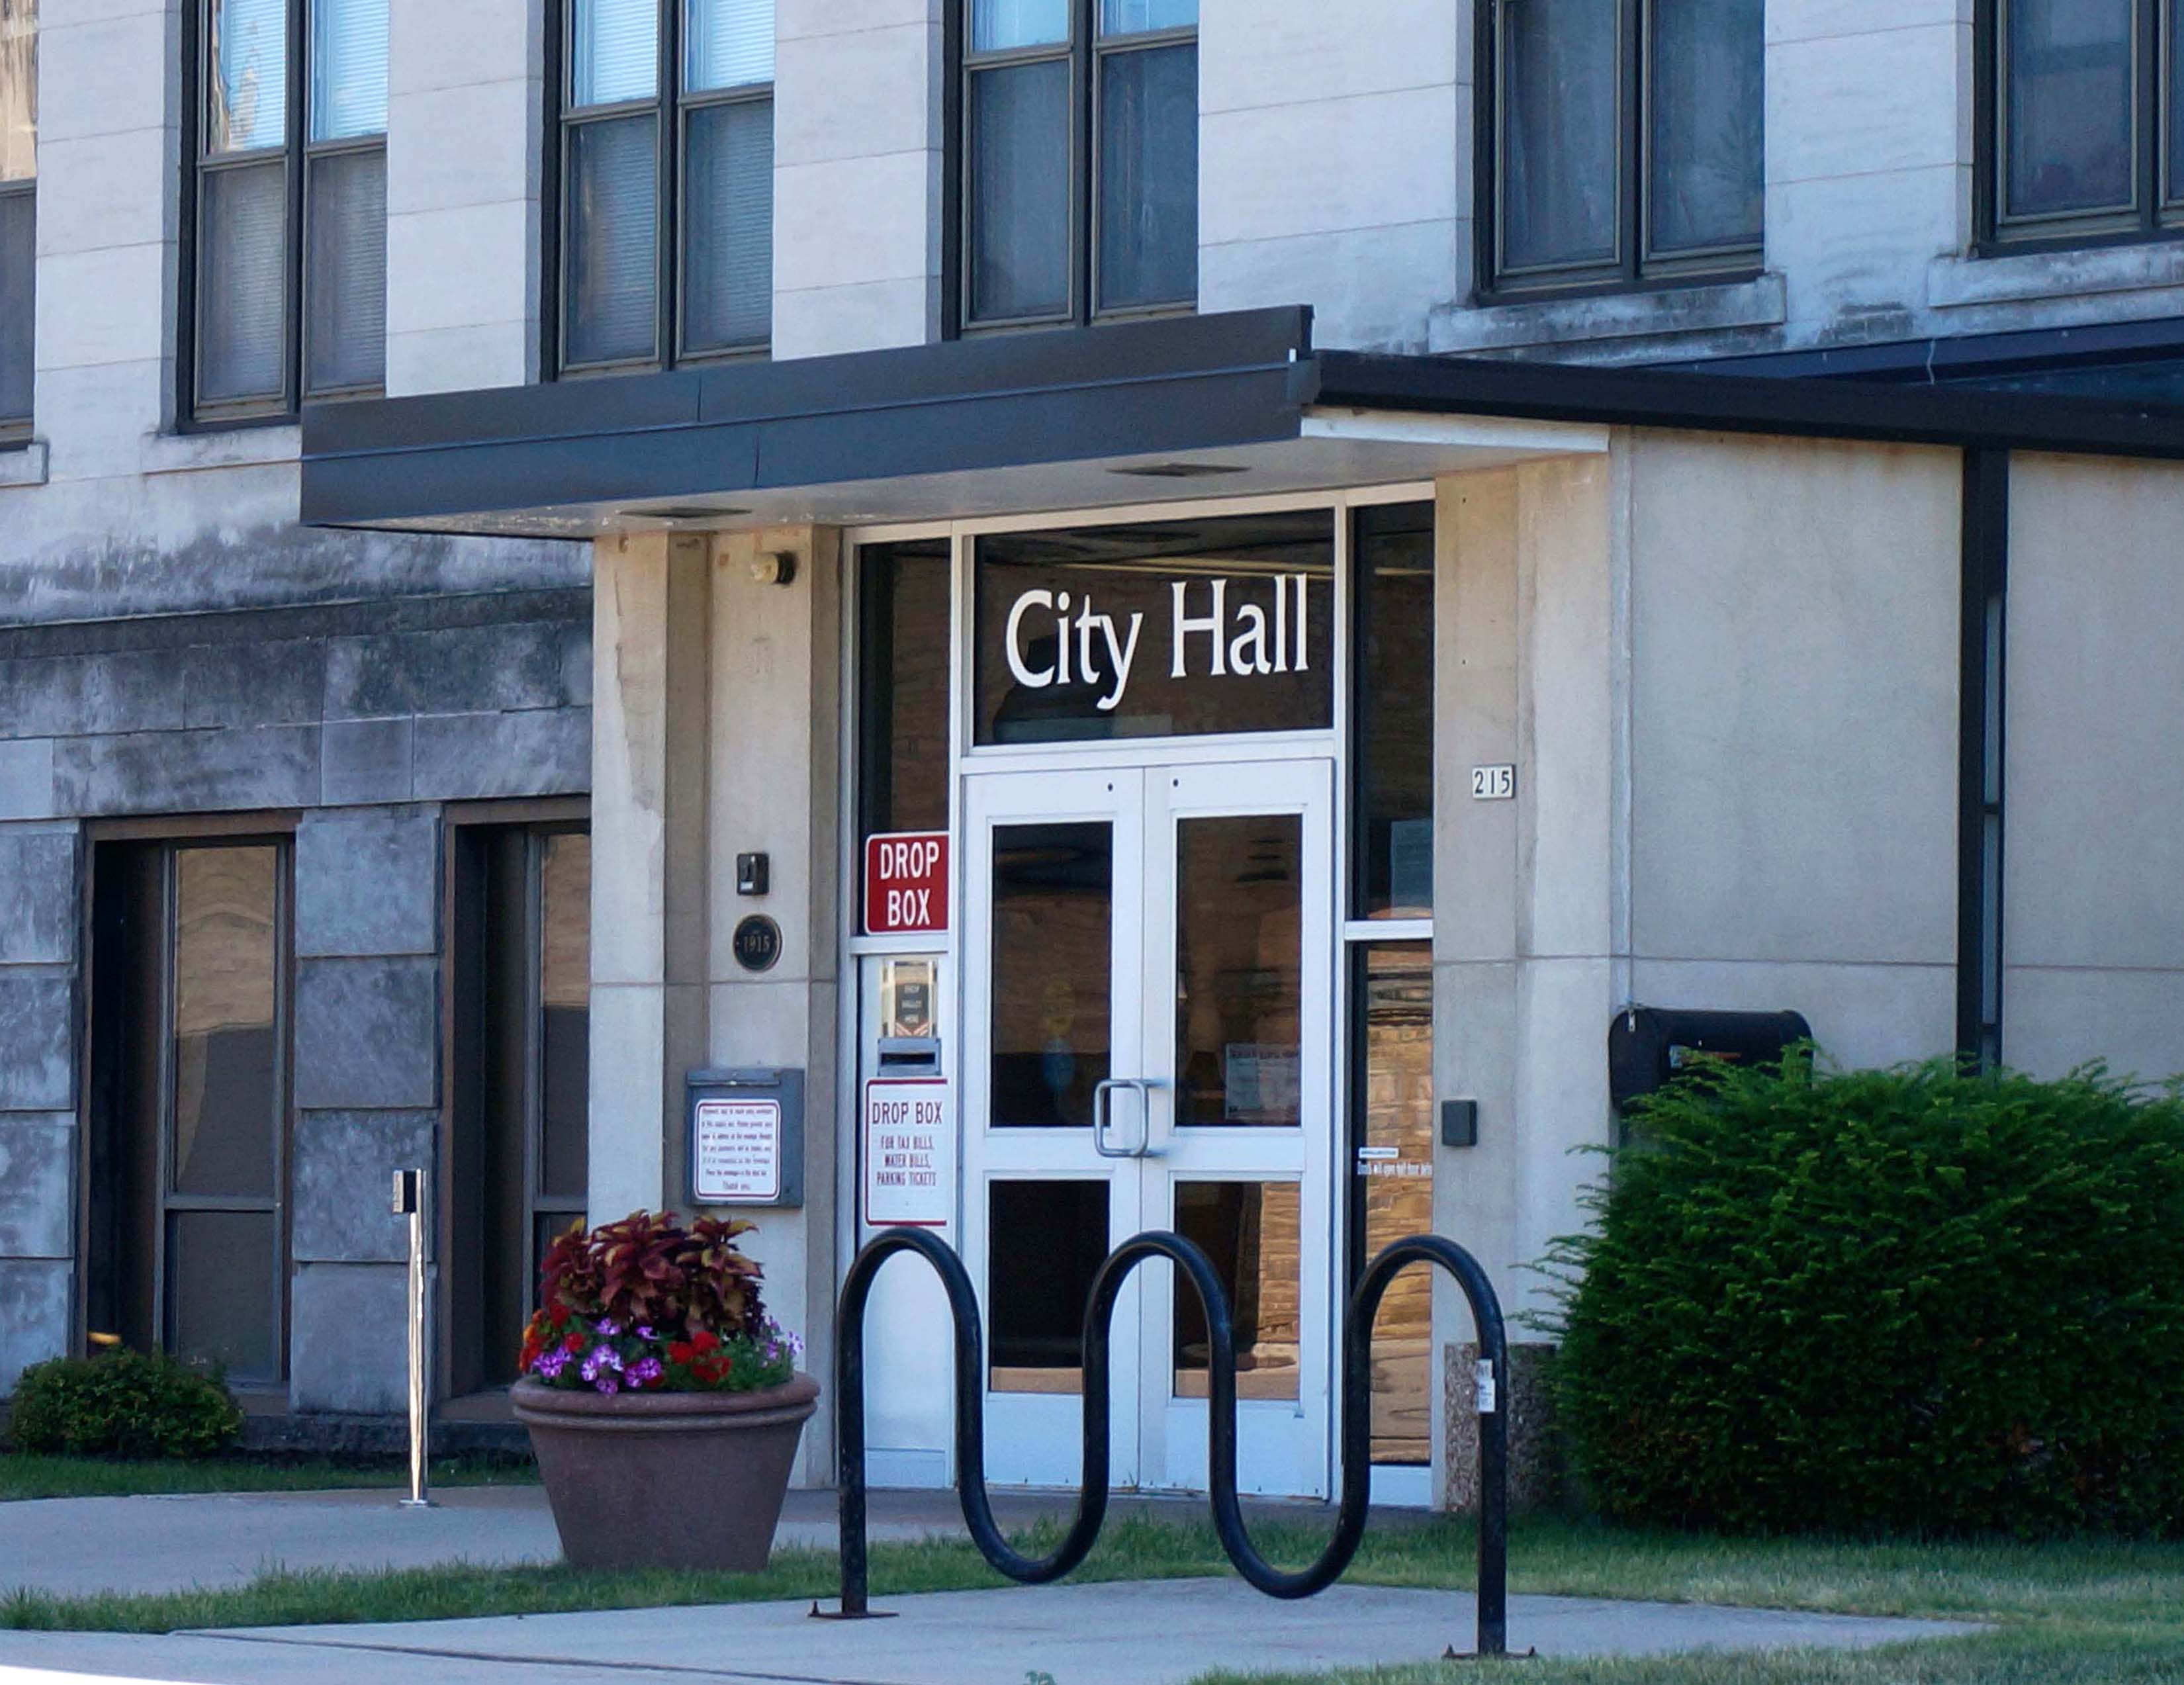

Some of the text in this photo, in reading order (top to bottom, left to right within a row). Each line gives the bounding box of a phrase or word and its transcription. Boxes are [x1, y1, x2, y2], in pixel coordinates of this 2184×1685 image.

[1006, 572, 1309, 711] City Hall
[1475, 770, 1510, 794] 215
[880, 841, 940, 880] DROP
[887, 888, 931, 927] BOX
[872, 1102, 942, 1124] DROP BOX
[881, 1135, 894, 1149] FOR
[877, 1171, 936, 1186] PARKING TICKETS
